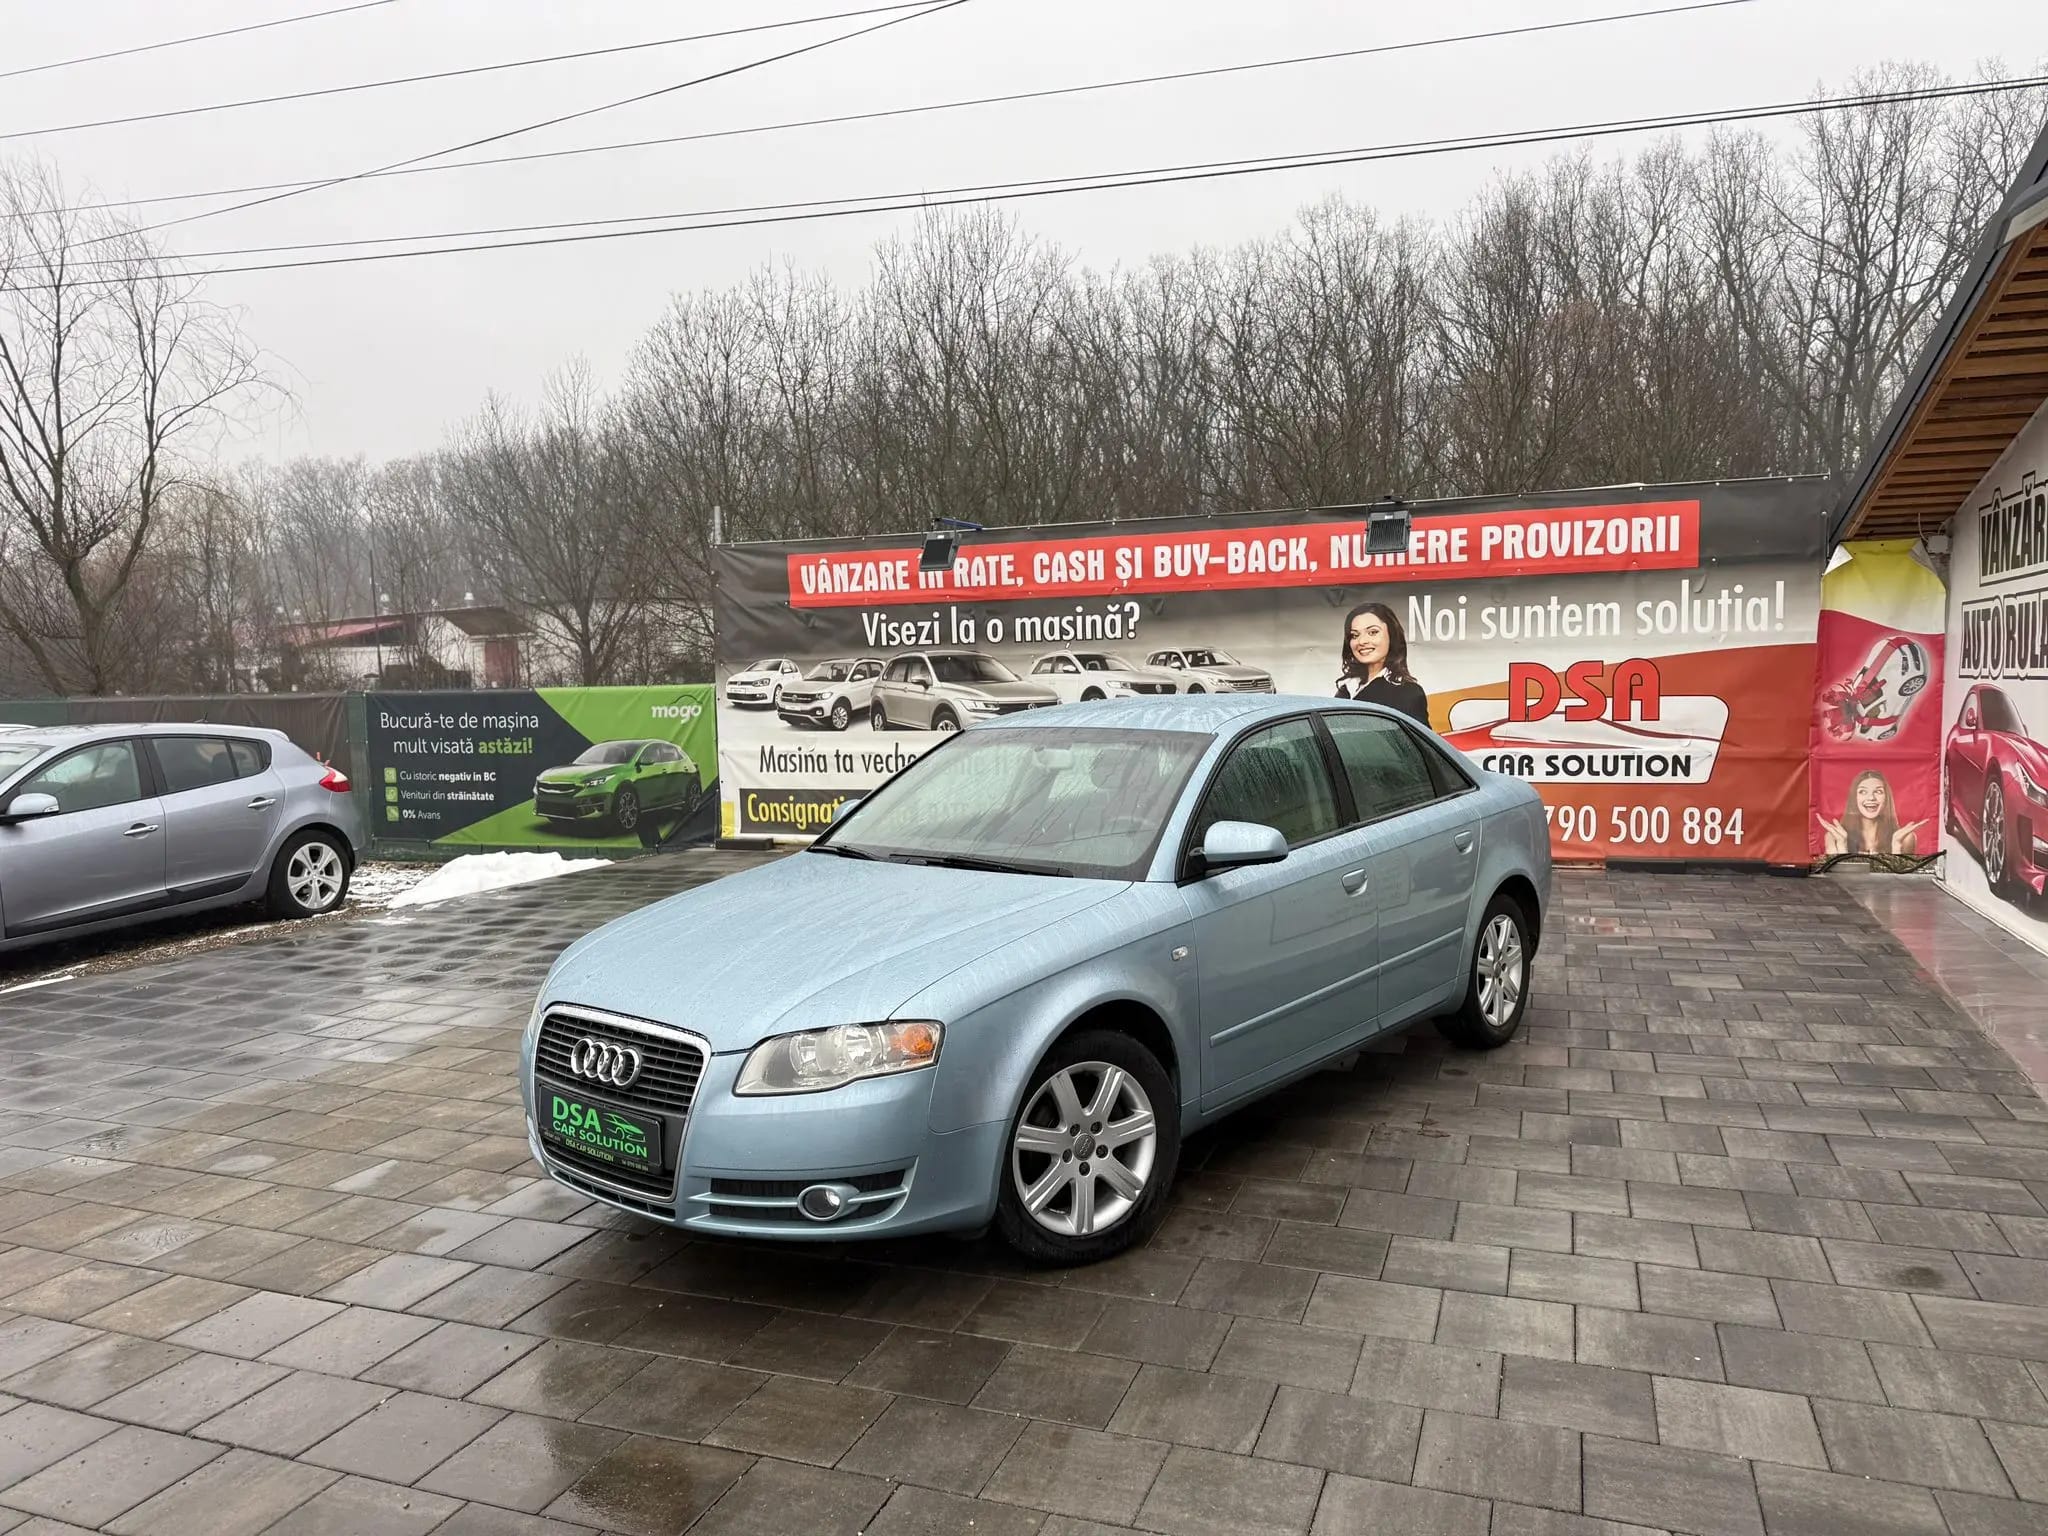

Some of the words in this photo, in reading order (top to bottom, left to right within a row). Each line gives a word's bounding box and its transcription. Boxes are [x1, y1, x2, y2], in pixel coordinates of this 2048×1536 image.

[1981, 483, 2048, 577] VÂNZĂR
[801, 558, 910, 594] VÂNZARE
[953, 554, 1024, 588] RATE,
[1033, 548, 1105, 584] CASH
[1115, 547, 1142, 587] ȘI
[1153, 537, 1318, 578] BUY-BACK,
[1481, 515, 1680, 561] PROVIZORII
[861, 610, 941, 647] Visezi
[950, 605, 976, 645] la
[986, 620, 1004, 644] o
[1015, 601, 1141, 649] mașină?
[1408, 594, 1467, 642] Noi
[1481, 596, 1621, 640] suntem
[1636, 579, 1785, 643] soluția!
[1961, 606, 2001, 670] AUTO
[1508, 658, 1660, 722] DSA
[380, 712, 455, 729] Bucură-te
[458, 712, 478, 729] de
[482, 711, 539, 732] mașina
[651, 705, 703, 725] mogo
[393, 738, 428, 754] mult
[430, 737, 474, 754] visată
[478, 737, 534, 754] astăzi!
[834, 747, 854, 773] ta
[400, 770, 412, 781] Cu
[413, 771, 437, 781] istoric
[438, 771, 472, 783] negativ
[483, 771, 497, 782] BC
[1482, 754, 1535, 777] CAR
[1545, 754, 1692, 777] SOLUTION
[400, 790, 431, 800] Venituri
[433, 790, 446, 800] din
[747, 793, 845, 830] Consigna
[402, 809, 417, 819] 0%
[417, 810, 441, 820] Avans
[1609, 805, 1670, 844] 500
[1682, 806, 1745, 846] 884
[552, 1095, 602, 1133] DSA
[552, 1120, 576, 1137] CAR
[579, 1129, 648, 1158] SOLUTION
[565, 1138, 576, 1149] DSA
[576, 1143, 587, 1152] CAR
[587, 1147, 614, 1162] SOLUTION
